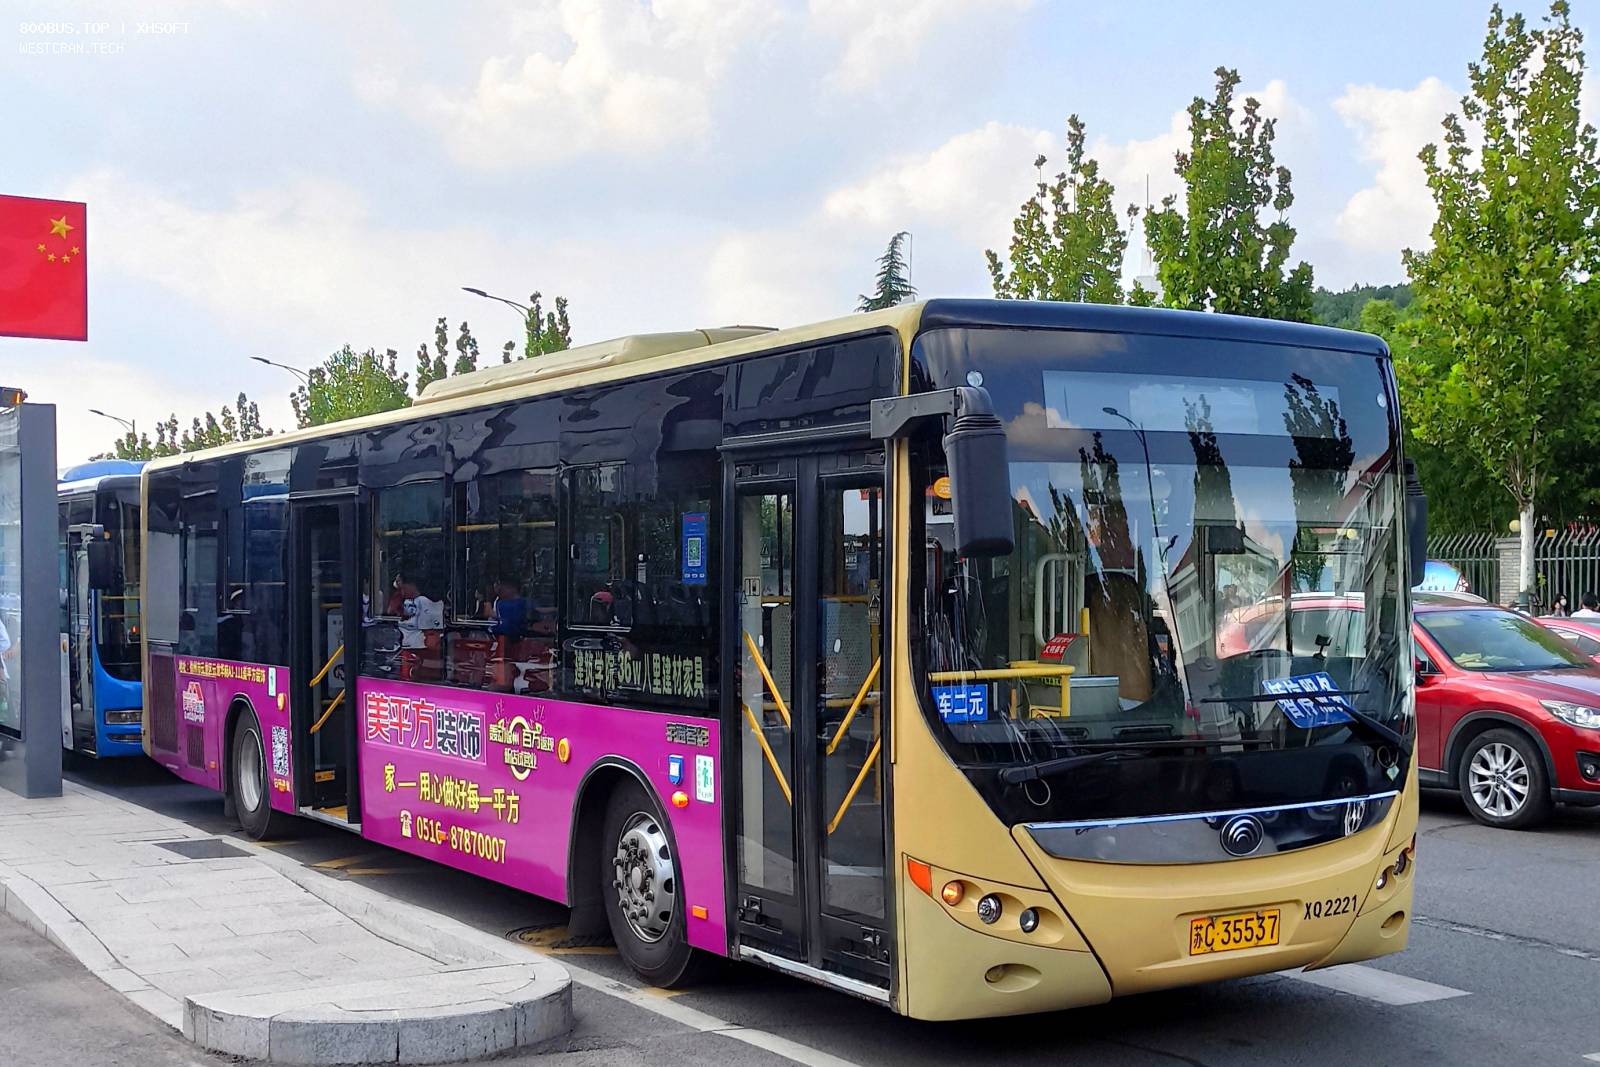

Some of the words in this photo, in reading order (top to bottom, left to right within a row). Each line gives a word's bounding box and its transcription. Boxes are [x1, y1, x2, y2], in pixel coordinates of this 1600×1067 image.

[367, 692, 481, 760] 美平方装饰
[1303, 895, 1358, 920] XQ2221
